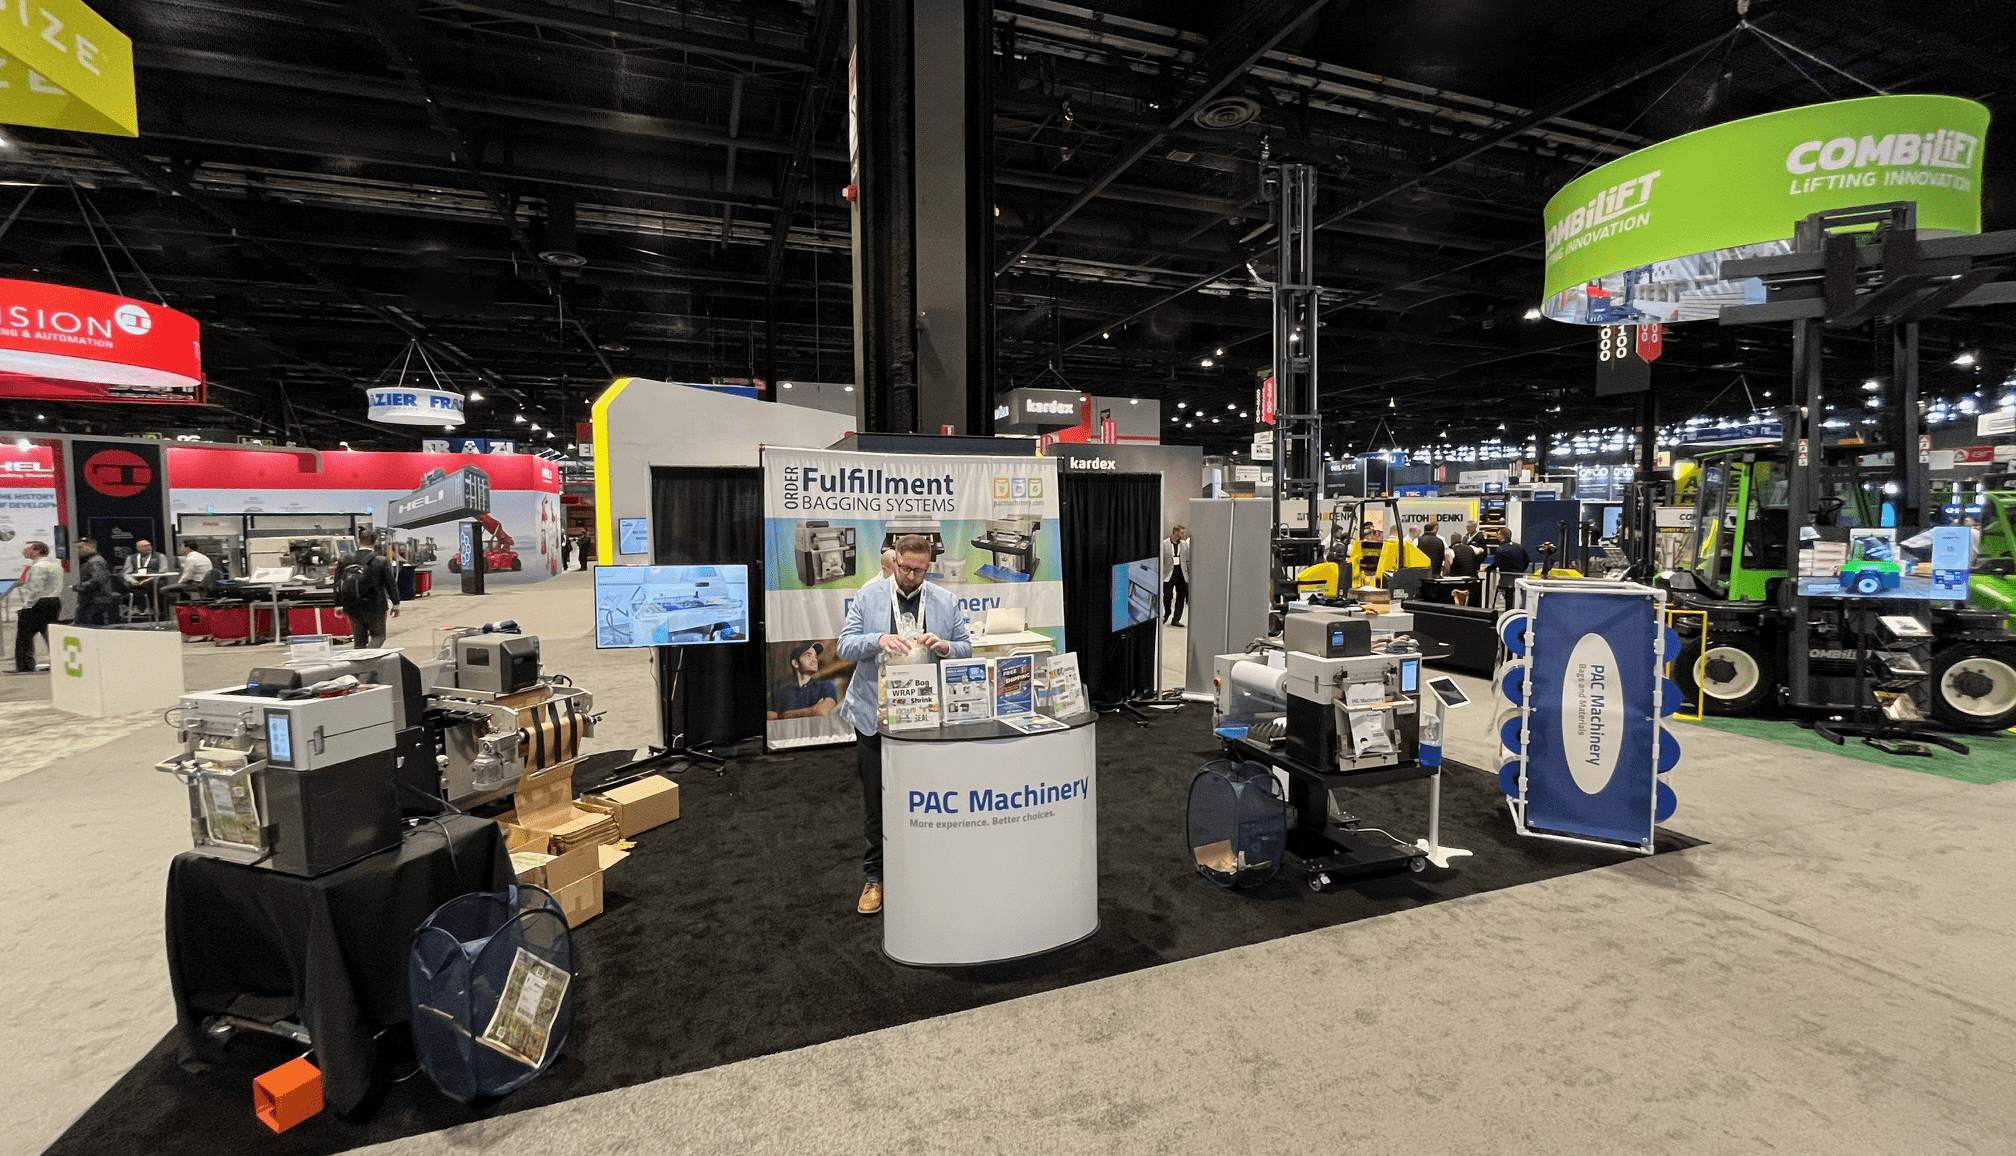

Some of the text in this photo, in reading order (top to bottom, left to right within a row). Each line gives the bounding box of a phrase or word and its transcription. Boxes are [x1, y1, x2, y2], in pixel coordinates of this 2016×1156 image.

[0, 305, 112, 339] SION
[34, 332, 113, 348] AUTOMATION
[1026, 399, 1074, 414] kardex
[1070, 457, 1116, 470] kardex
[784, 466, 799, 510] ORDER
[802, 467, 954, 496] Fulfillment
[399, 490, 444, 513] HELI
[802, 495, 955, 513] BAGGING SYSTEMS
[1436, 513, 1464, 522] DENKI
[1002, 669, 1018, 677] FREE
[1005, 672, 1031, 684] SHIPPING
[915, 680, 930, 688] Bag
[892, 688, 916, 697] WRAP
[1576, 663, 1587, 736] Bags and Materials
[910, 697, 933, 705] Shrink
[914, 714, 929, 723] SEAL
[1585, 664, 1605, 766] PAC Machinery
[909, 776, 1089, 814] PAC Machinery
[910, 810, 1056, 830] More experience. Better choices.
